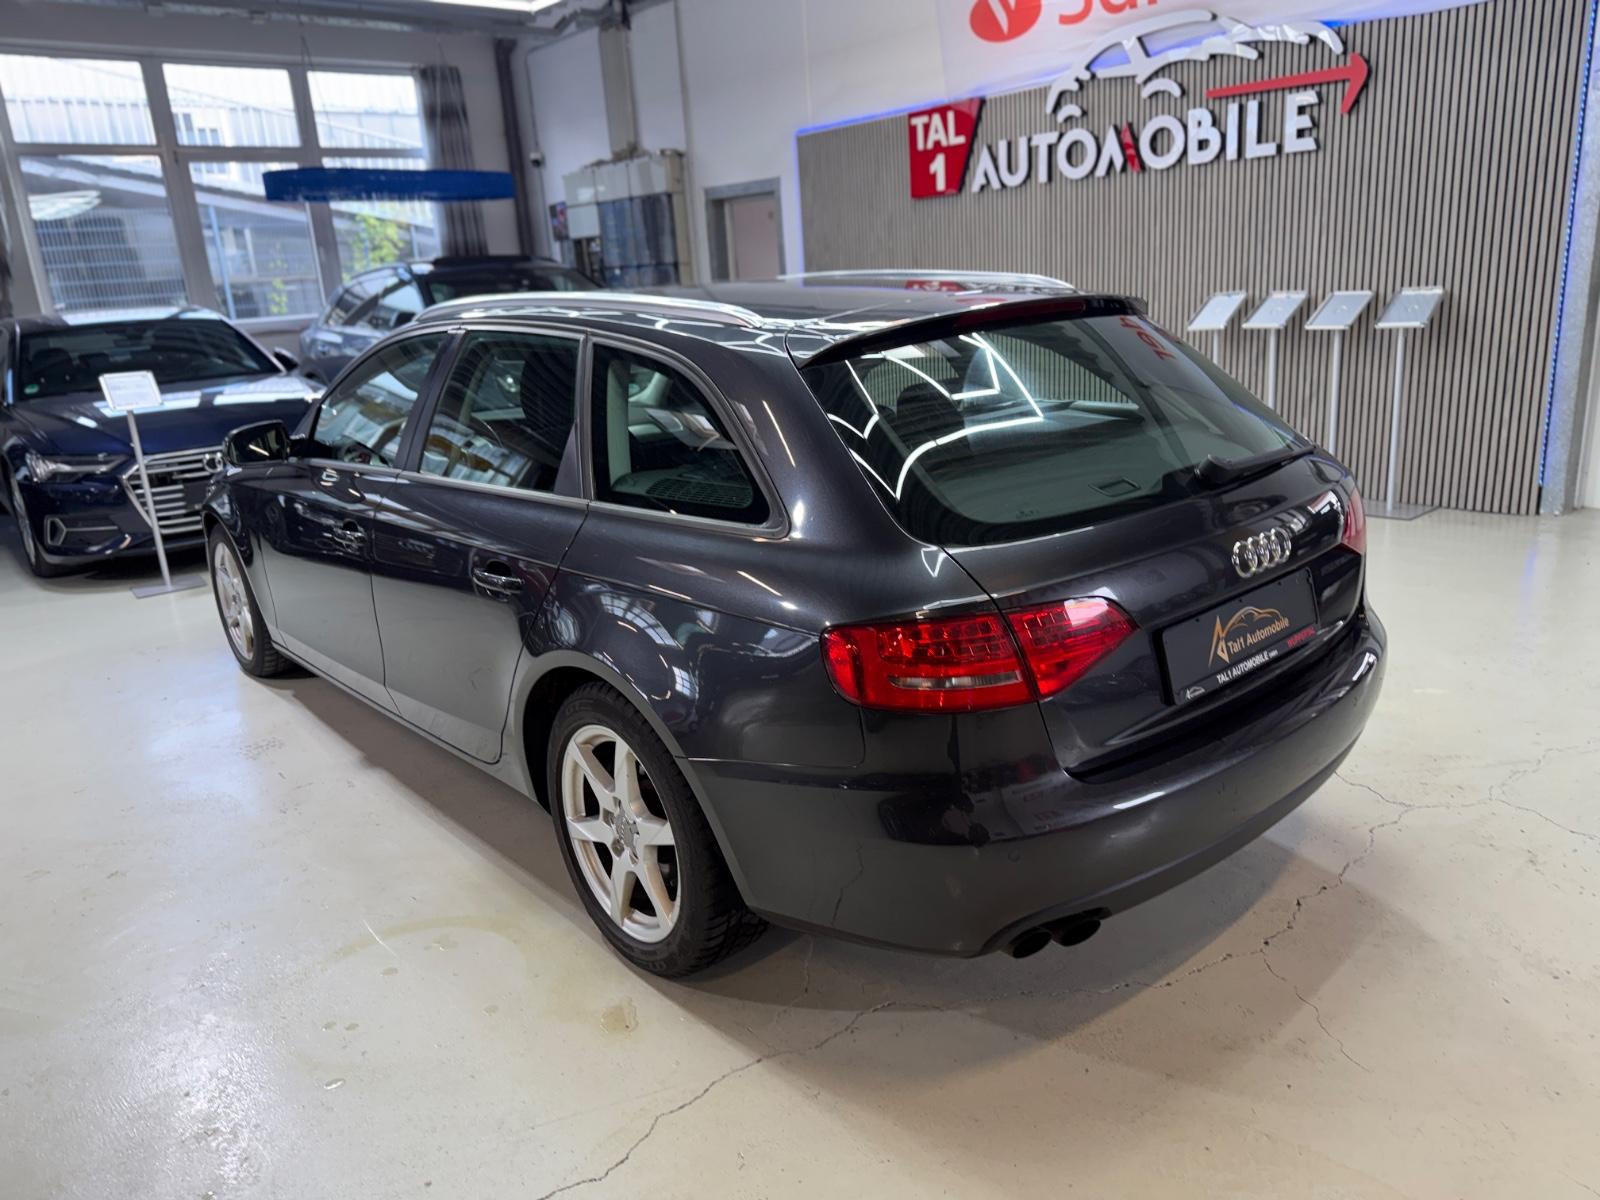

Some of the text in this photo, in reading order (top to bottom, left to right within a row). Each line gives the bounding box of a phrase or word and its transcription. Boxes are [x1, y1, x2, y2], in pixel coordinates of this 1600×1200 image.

[909, 110, 966, 151] TAL
[971, 91, 1319, 192] AUTOMOBILE
[928, 153, 947, 193] 1
[1247, 618, 1289, 646] Automobile
[1232, 650, 1270, 677] AUTOMOBILE
